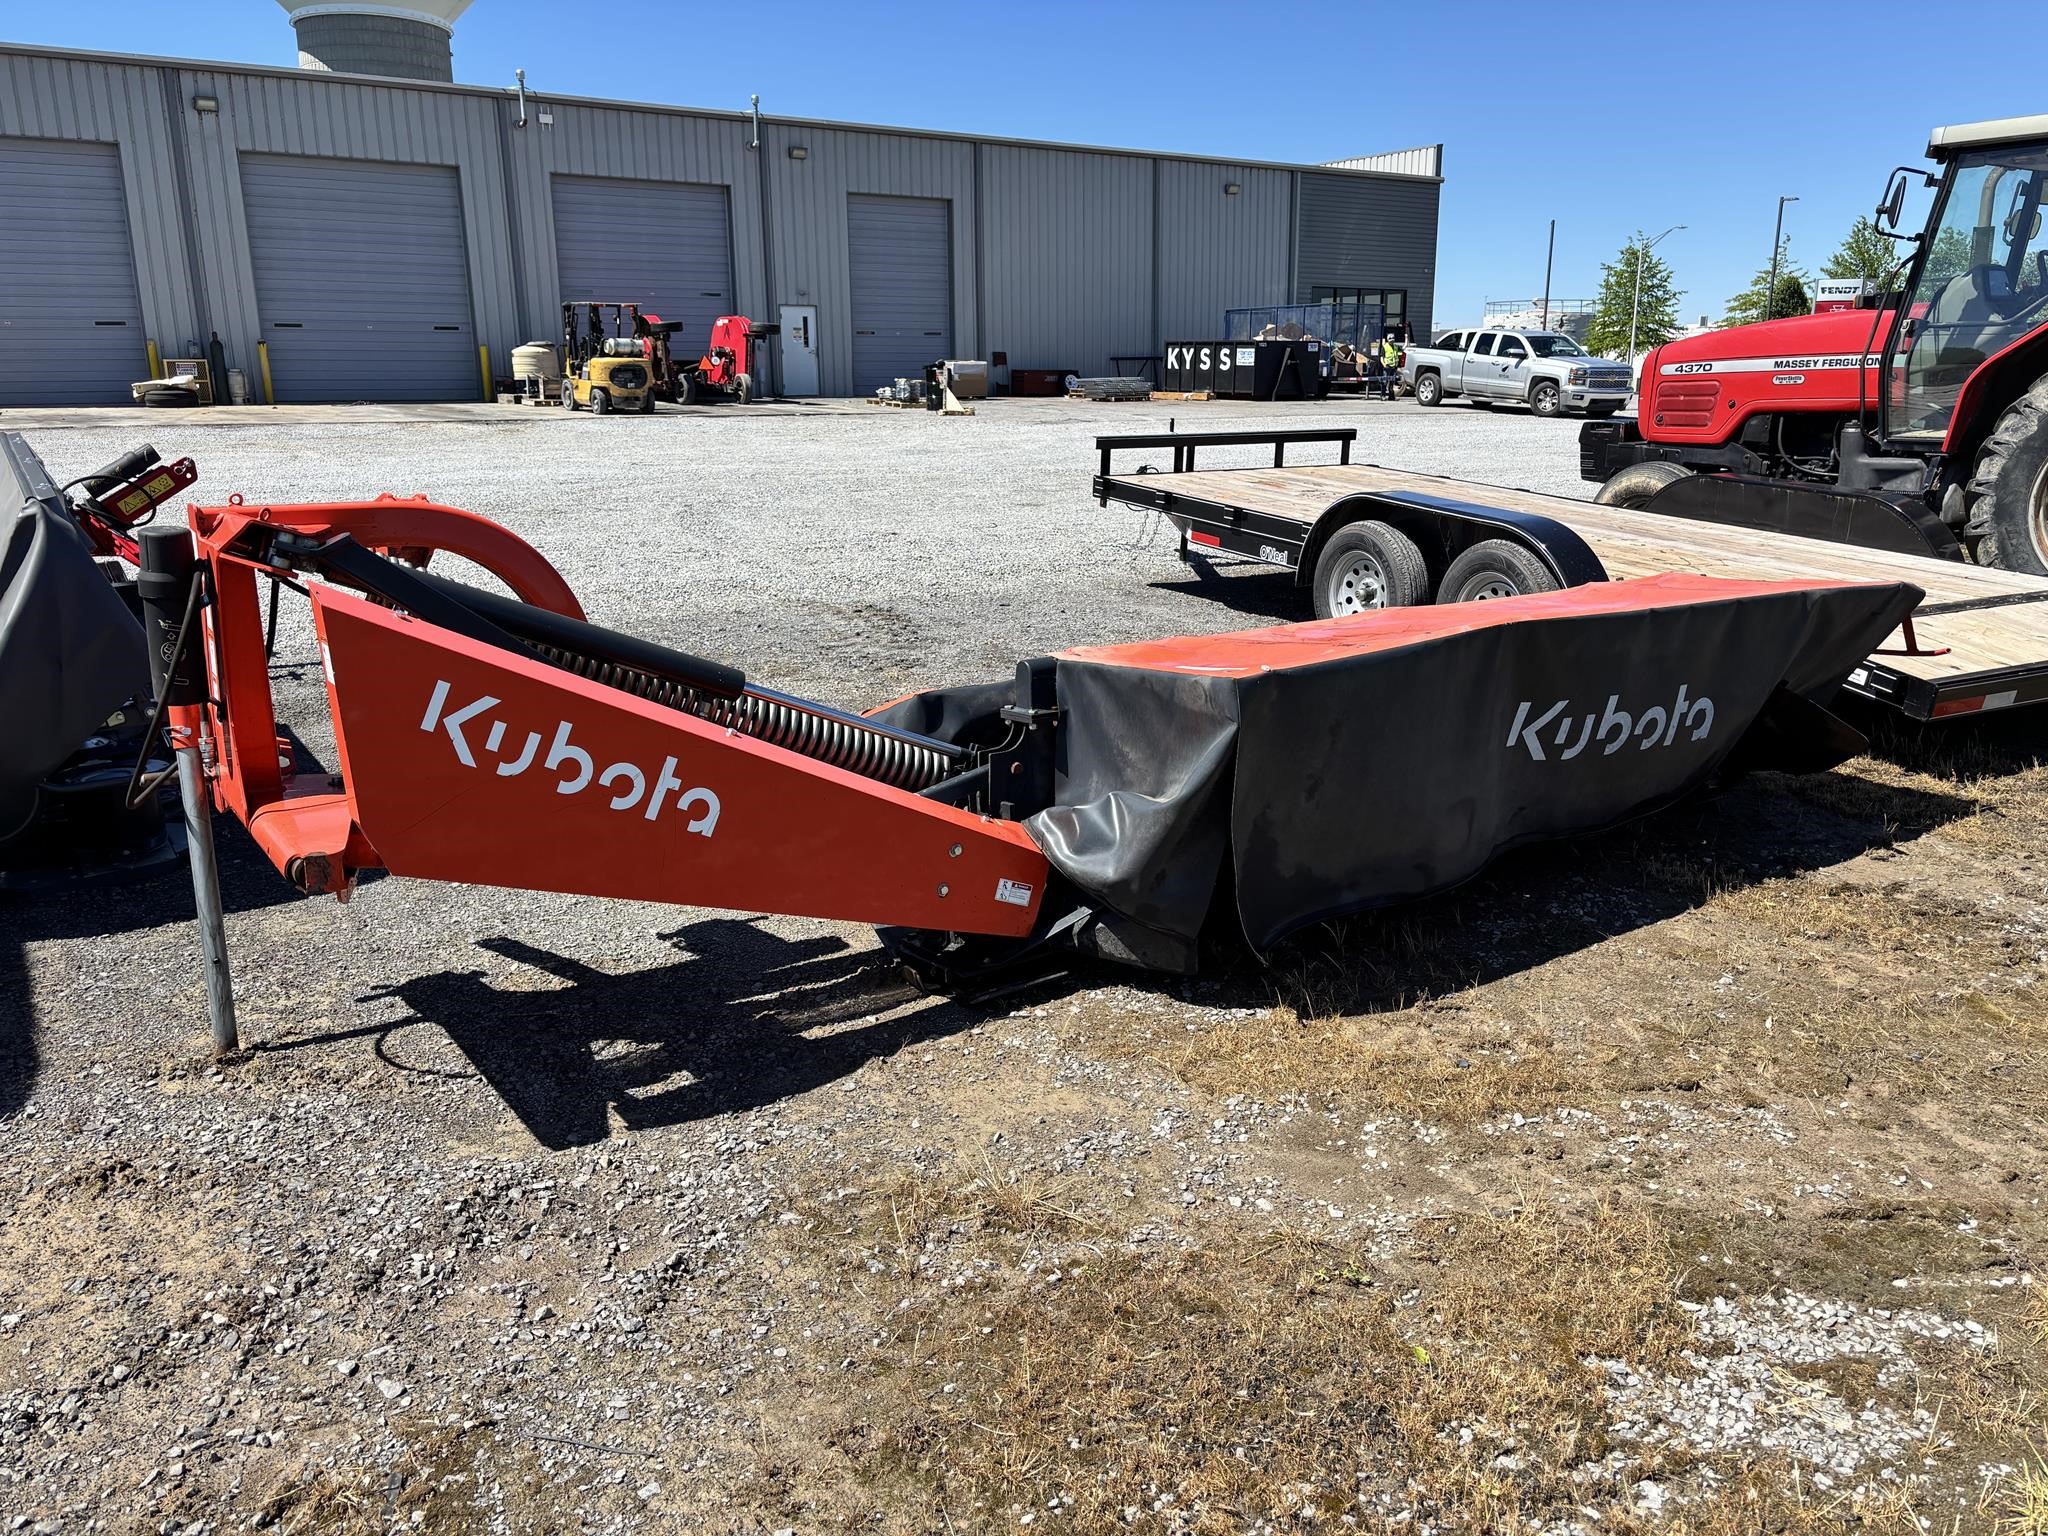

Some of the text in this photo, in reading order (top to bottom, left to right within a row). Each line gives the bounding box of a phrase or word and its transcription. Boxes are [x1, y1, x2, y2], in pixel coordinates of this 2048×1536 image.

[1820, 286, 1860, 294] FENDT
[1675, 363, 1713, 373] 4370
[1773, 359, 1820, 369] MASSEY
[1260, 545, 1288, 565] O'Neal
[1506, 684, 1715, 761] Kubota
[420, 679, 721, 838] Kubota
